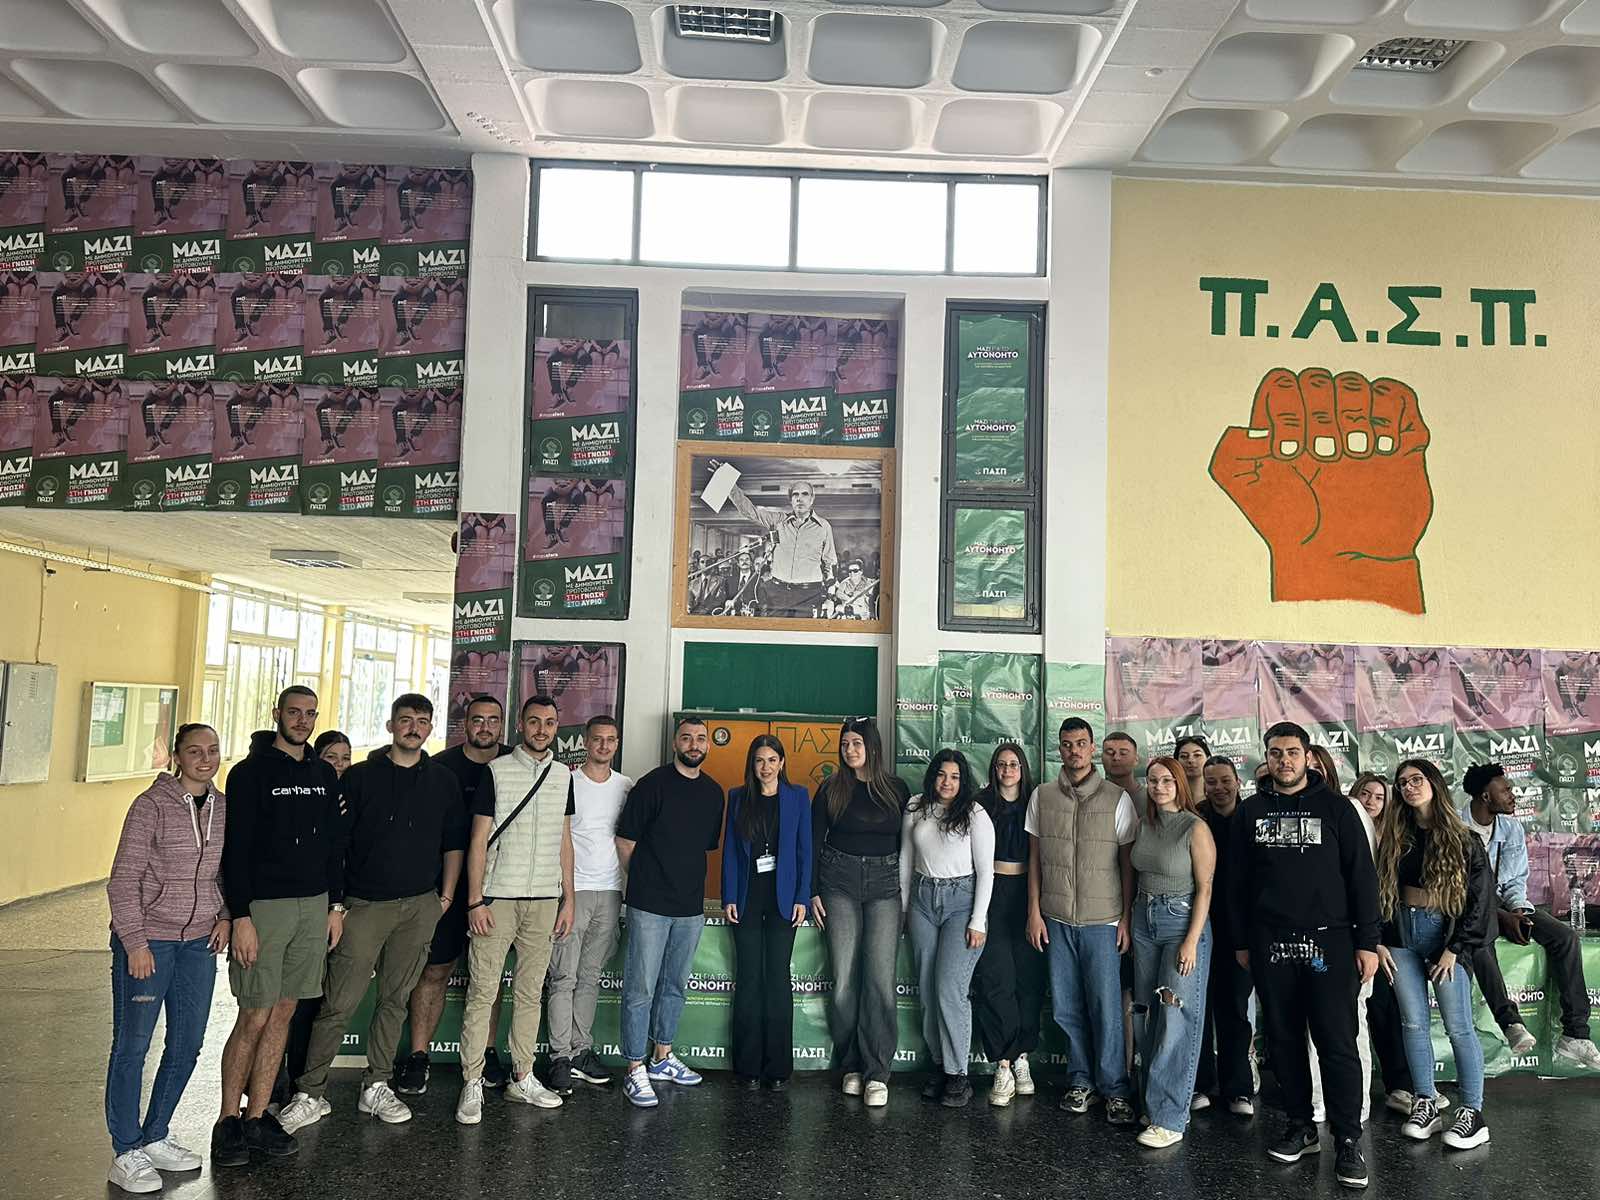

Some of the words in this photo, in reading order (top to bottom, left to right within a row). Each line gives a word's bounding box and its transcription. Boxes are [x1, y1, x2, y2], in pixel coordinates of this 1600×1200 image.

[84, 235, 132, 256] ΜΑΖΙ
[172, 240, 220, 258] ΜΑΖΙ
[264, 242, 312, 261] ΜΑΖΙ
[353, 247, 380, 264] ΜΑ
[418, 249, 465, 267] ΜΑΖΙ
[0, 353, 35, 371] ΑΖΙ
[75, 354, 124, 374] ΜΑΖΙ
[967, 351, 1018, 359] ΑΥΤΟΝΟΗΤΟ
[166, 354, 214, 375] ΜΑΖΙ
[254, 355, 302, 375] ΜΑΖΙ
[343, 359, 378, 377] ΜΑ
[416, 359, 464, 379] ΜΑΖΙ
[716, 395, 744, 413] ΜΑ
[781, 396, 827, 415] ΜΑΖΙ
[842, 399, 888, 418] ΜΑΖΙ
[571, 422, 619, 441] ΜΑΖΙ
[965, 424, 1016, 432] ΑΥΤΟΝΟΗΤΟ
[0, 456, 33, 475] ΑΖΙ
[70, 461, 118, 480] ΜΑΖΙ
[250, 464, 299, 484] ΜΑΖΙ
[983, 467, 1006, 475] ΠΑΣΠ
[340, 468, 377, 487] ΜΑΖ
[415, 472, 457, 489] ΜΑΖ
[356, 495, 375, 503] ΓΝΩΣ
[964, 546, 1016, 554] ΑΥΤΟΝΟΗΤΟ
[564, 563, 613, 583] ΜΑΖΙ
[982, 590, 1006, 598] ΠΑΣΠ
[455, 598, 504, 618] ΜΑΖΙ
[981, 692, 1032, 700] ΑΥΤΟΝΟΗΤΟ
[897, 703, 938, 711] ΤΟΝΟΗΤΟ
[1048, 701, 1101, 710] ΑΥΤΟΝΟΗΤΟ
[557, 733, 585, 752] ΜΑ
[776, 726, 840, 754] ΠΑΣ
[1145, 725, 1194, 746] ΜΑΖΙ
[1395, 733, 1446, 754] ΜΑΖΙ
[1490, 735, 1540, 755] ΜΑΖΙ
[705, 917, 725, 925] ΑΣ
[600, 970, 613, 978] ΑΖΙ
[685, 980, 736, 991] ΤΟΝΟΗΤ
[1507, 991, 1544, 1002] ΝΟΗΤΟ
[342, 1034, 359, 1045] ΣΠ
[535, 1043, 549, 1053] ΣΠ
[603, 1044, 621, 1055] ΠΑ
[691, 1046, 725, 1057] ΠΑΣΠ
[793, 1047, 825, 1058] ΠΑΣΠ
[893, 1050, 916, 1061] ΑΣΠ
[1051, 1053, 1068, 1063] ΠΑ
[1510, 1055, 1539, 1067] ΠΑΣΠ
